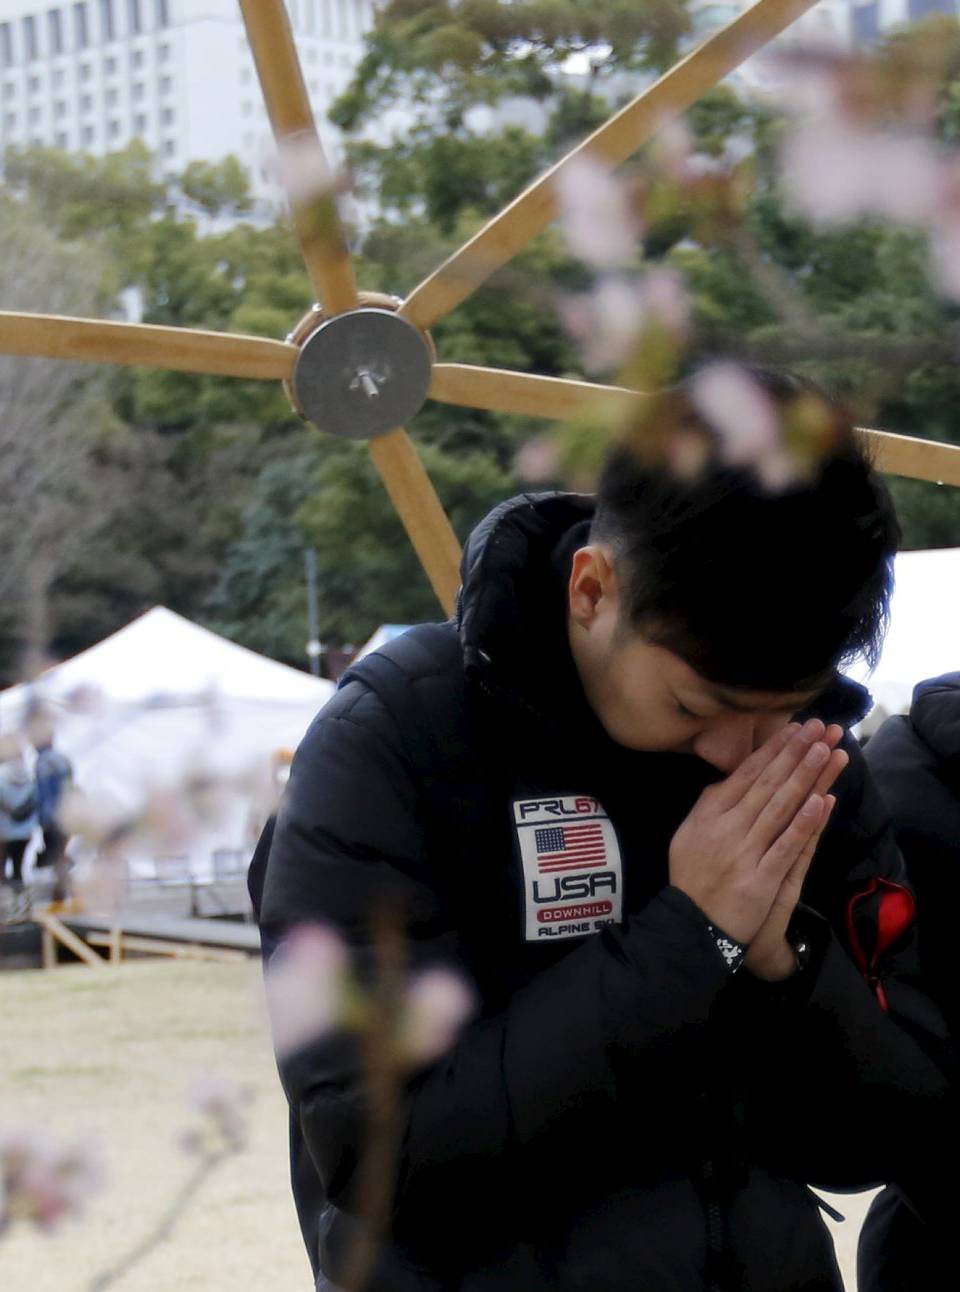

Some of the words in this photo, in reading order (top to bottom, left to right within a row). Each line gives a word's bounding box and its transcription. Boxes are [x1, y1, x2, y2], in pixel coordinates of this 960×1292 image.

[532, 871, 616, 903] USA
[543, 903, 610, 921] DOWNHILL
[538, 922, 590, 936] ALPINE
